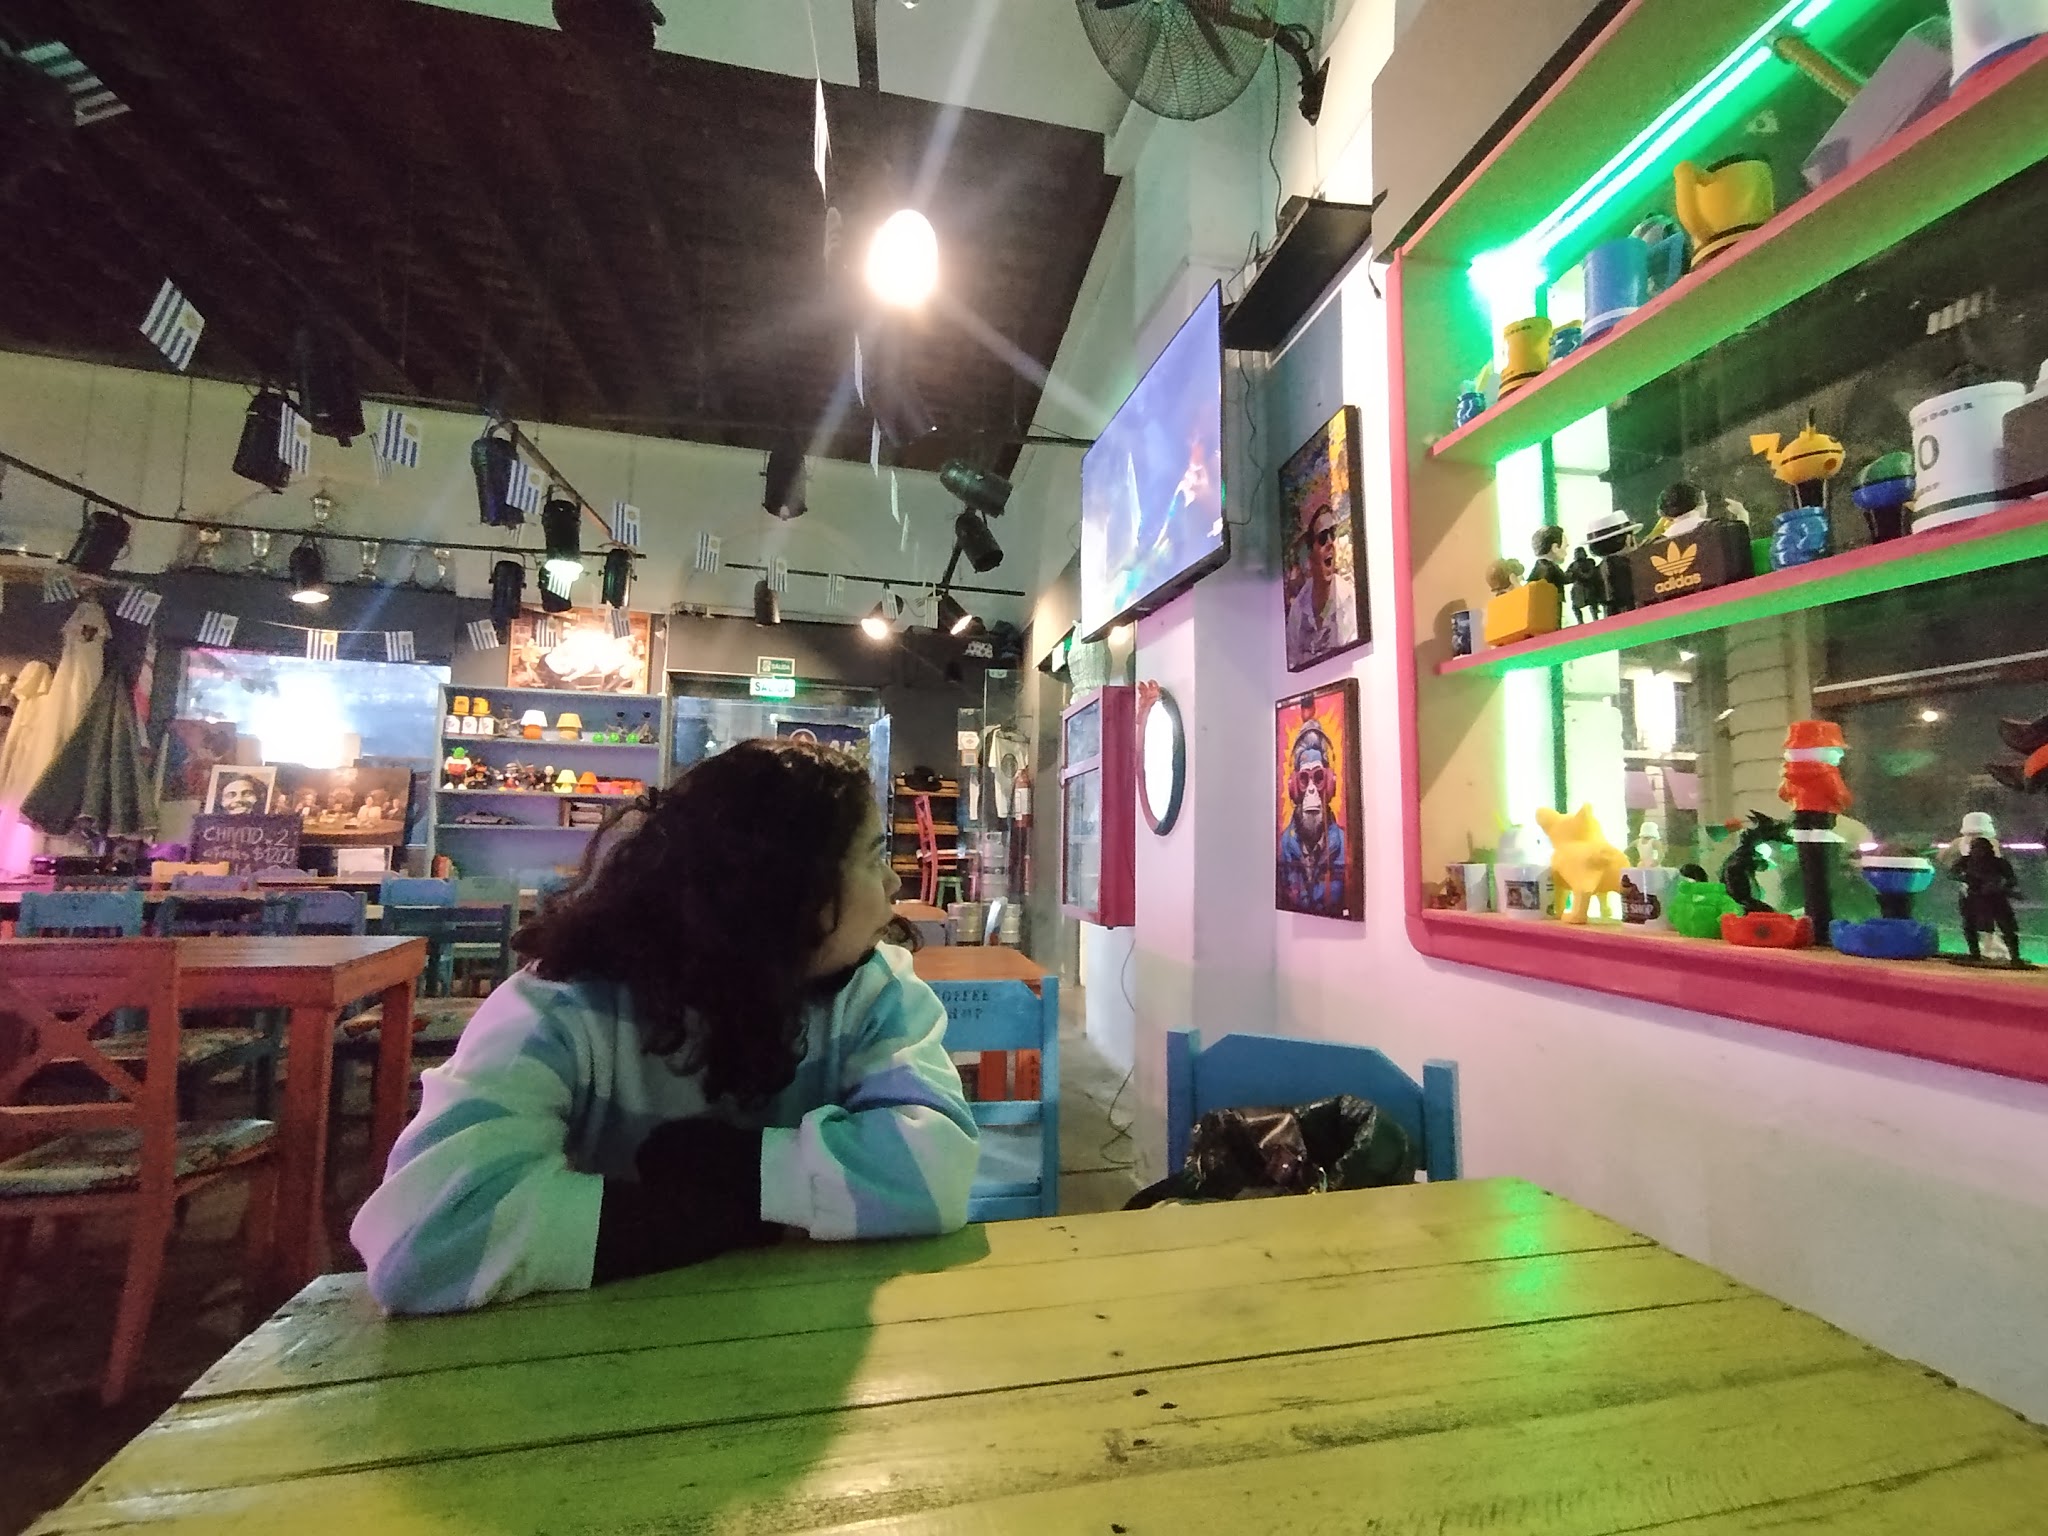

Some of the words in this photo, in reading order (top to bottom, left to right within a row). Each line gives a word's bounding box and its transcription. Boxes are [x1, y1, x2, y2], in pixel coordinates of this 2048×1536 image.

[1654, 572, 1702, 594] adidas
[771, 663, 791, 671] SALIDA
[755, 681, 790, 693] SALDA
[940, 989, 989, 1002] OFFEE
[947, 1007, 984, 1020] HOP
